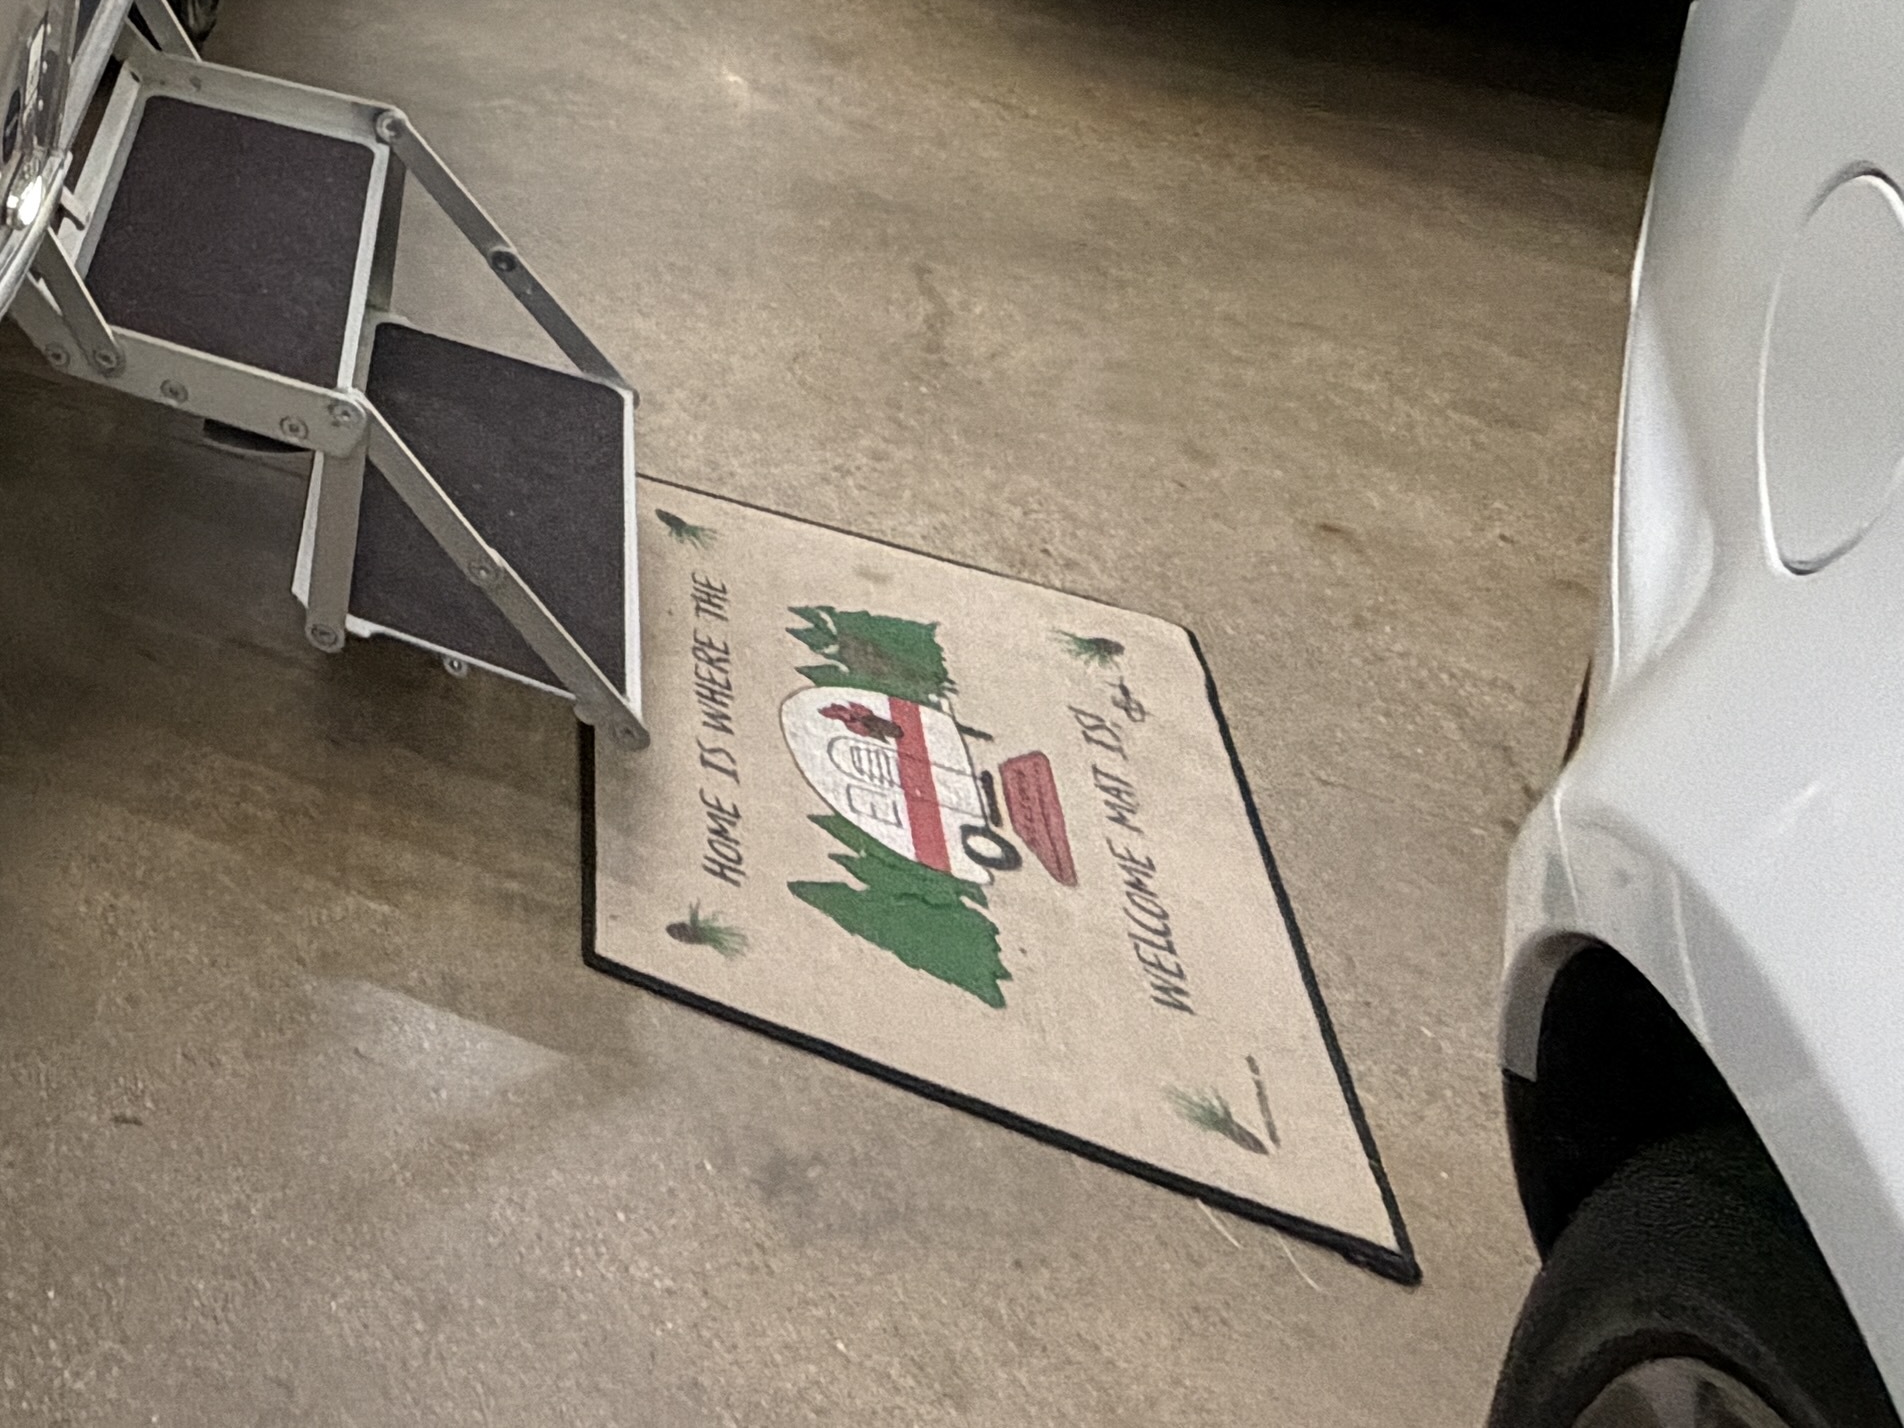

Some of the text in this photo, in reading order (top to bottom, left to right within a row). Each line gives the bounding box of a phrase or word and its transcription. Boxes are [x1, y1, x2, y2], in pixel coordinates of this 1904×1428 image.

[690, 571, 747, 889] HOME IS WHERE THE
[1092, 762, 1144, 835] MAT
[1104, 836, 1197, 1017] WELCOME
